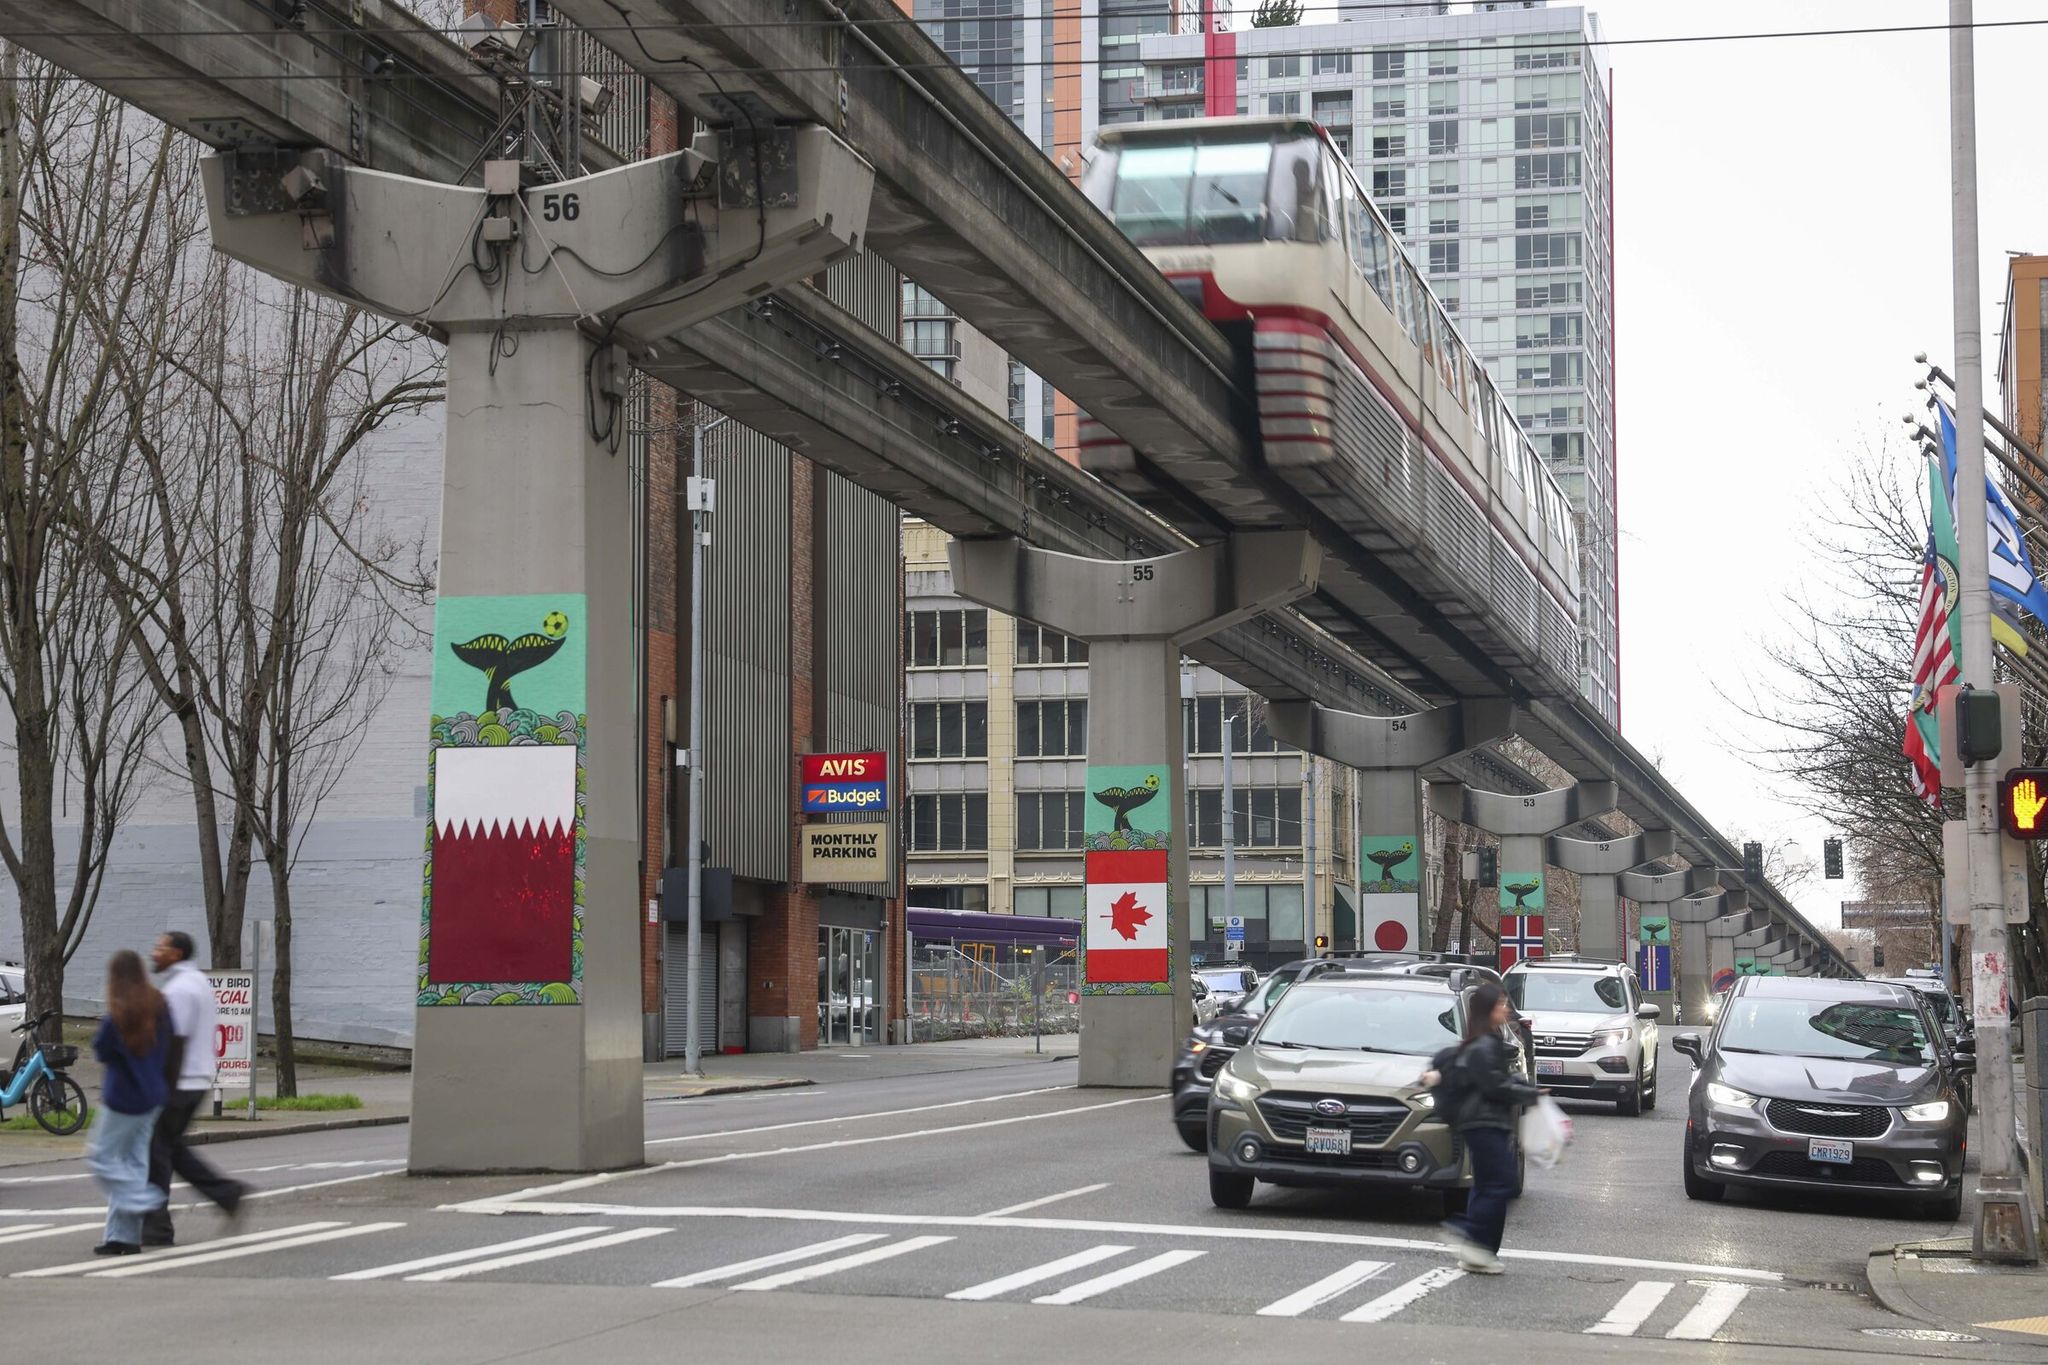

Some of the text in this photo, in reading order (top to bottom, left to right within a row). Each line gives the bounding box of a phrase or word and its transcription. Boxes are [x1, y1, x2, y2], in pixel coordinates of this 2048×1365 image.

[544, 193, 579, 222] 56
[1133, 565, 1154, 581] 55
[1938, 559, 1957, 594] HINGTON
[1392, 720, 1407, 731] 54
[820, 759, 866, 777] AVIS
[828, 788, 881, 807] Budget
[1523, 798, 1535, 807] 53
[811, 833, 878, 845] MONTHLY
[813, 847, 877, 859] PARKING
[227, 977, 251, 988] BIRD
[215, 990, 249, 1005] ECIAL
[230, 1007, 239, 1016] 10
[240, 1007, 251, 1016] AM
[1307, 1136, 1349, 1152] CRV0681
[1811, 1146, 1850, 1160] CMR1929
